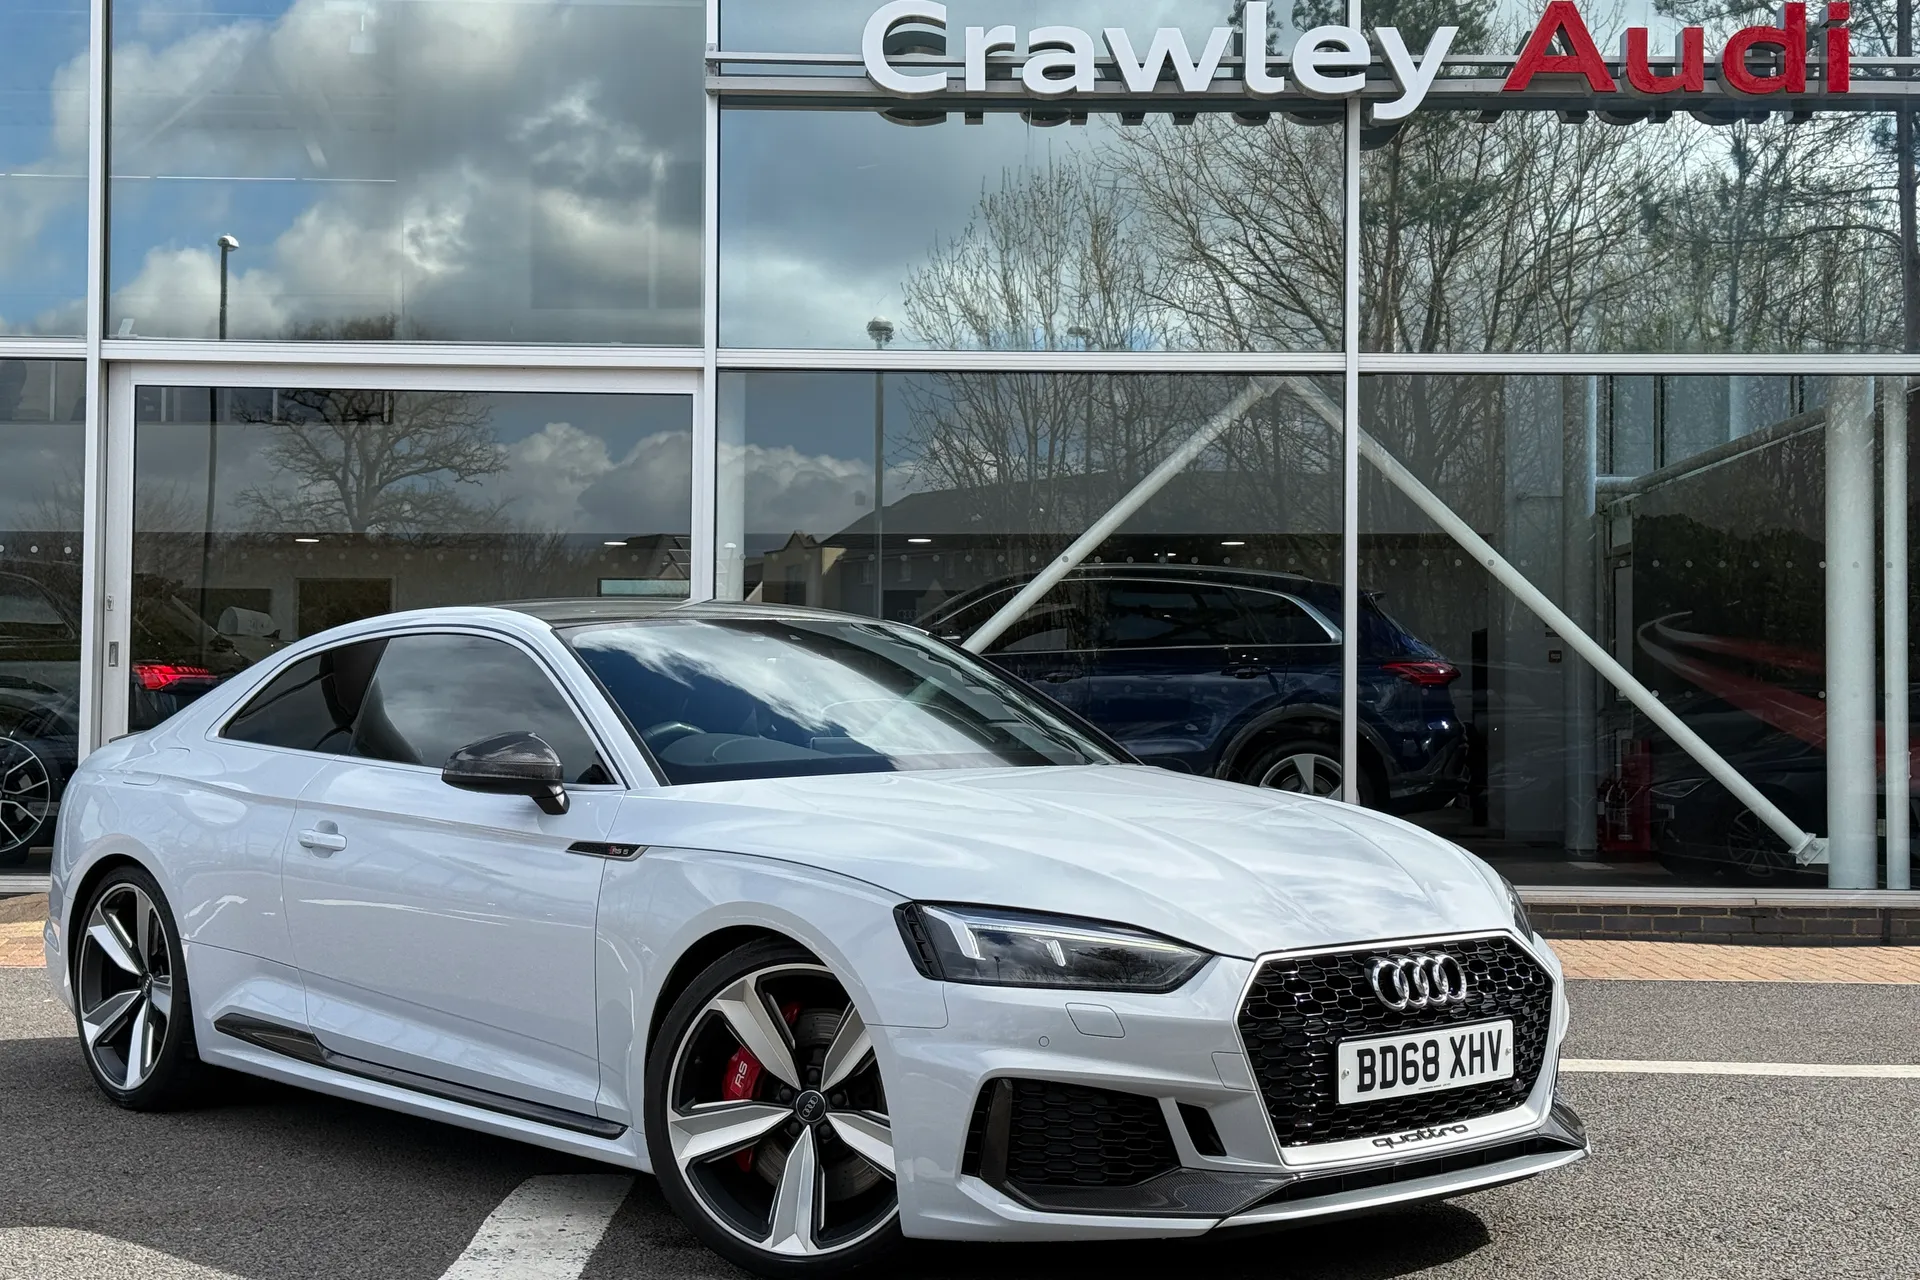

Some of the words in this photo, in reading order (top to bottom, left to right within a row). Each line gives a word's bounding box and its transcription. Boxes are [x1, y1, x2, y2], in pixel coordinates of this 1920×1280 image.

[862, 0, 1458, 120] Crawley
[1504, 0, 1850, 95] Audi
[735, 1060, 748, 1088] RS
[1356, 1039, 1440, 1093] BD68
[1450, 1028, 1503, 1079] XHV
[1372, 1124, 1469, 1149] quattro
